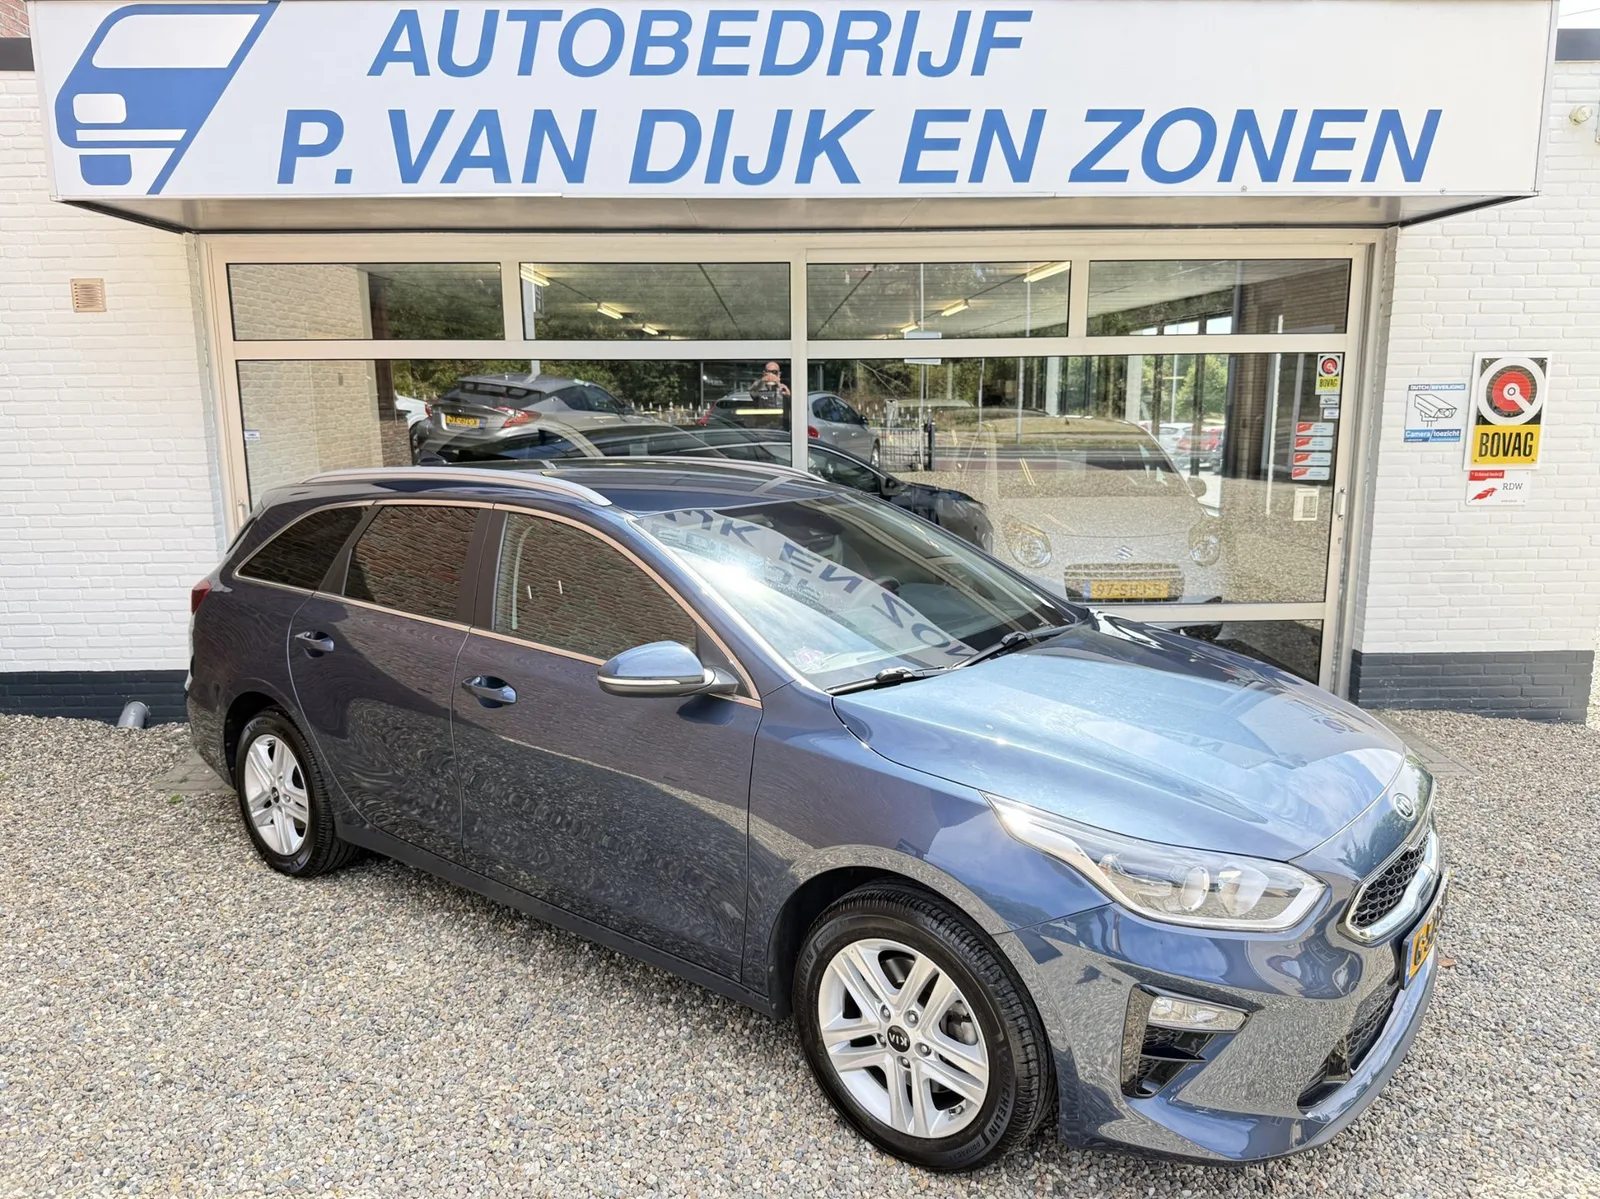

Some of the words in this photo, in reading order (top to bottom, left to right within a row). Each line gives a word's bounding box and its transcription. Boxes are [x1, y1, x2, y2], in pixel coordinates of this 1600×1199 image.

[368, 9, 1032, 77] AUTOBEDRIJF
[279, 110, 351, 183] P.
[389, 110, 596, 183] VAN
[630, 110, 871, 185] DIJK
[900, 110, 1046, 183] EN
[1070, 108, 1441, 183] ZONEN
[1319, 378, 1338, 388] BOVAG
[1478, 432, 1534, 458] BOVAG
[1502, 482, 1523, 491] RDW
[888, 1032, 908, 1047] KIA
